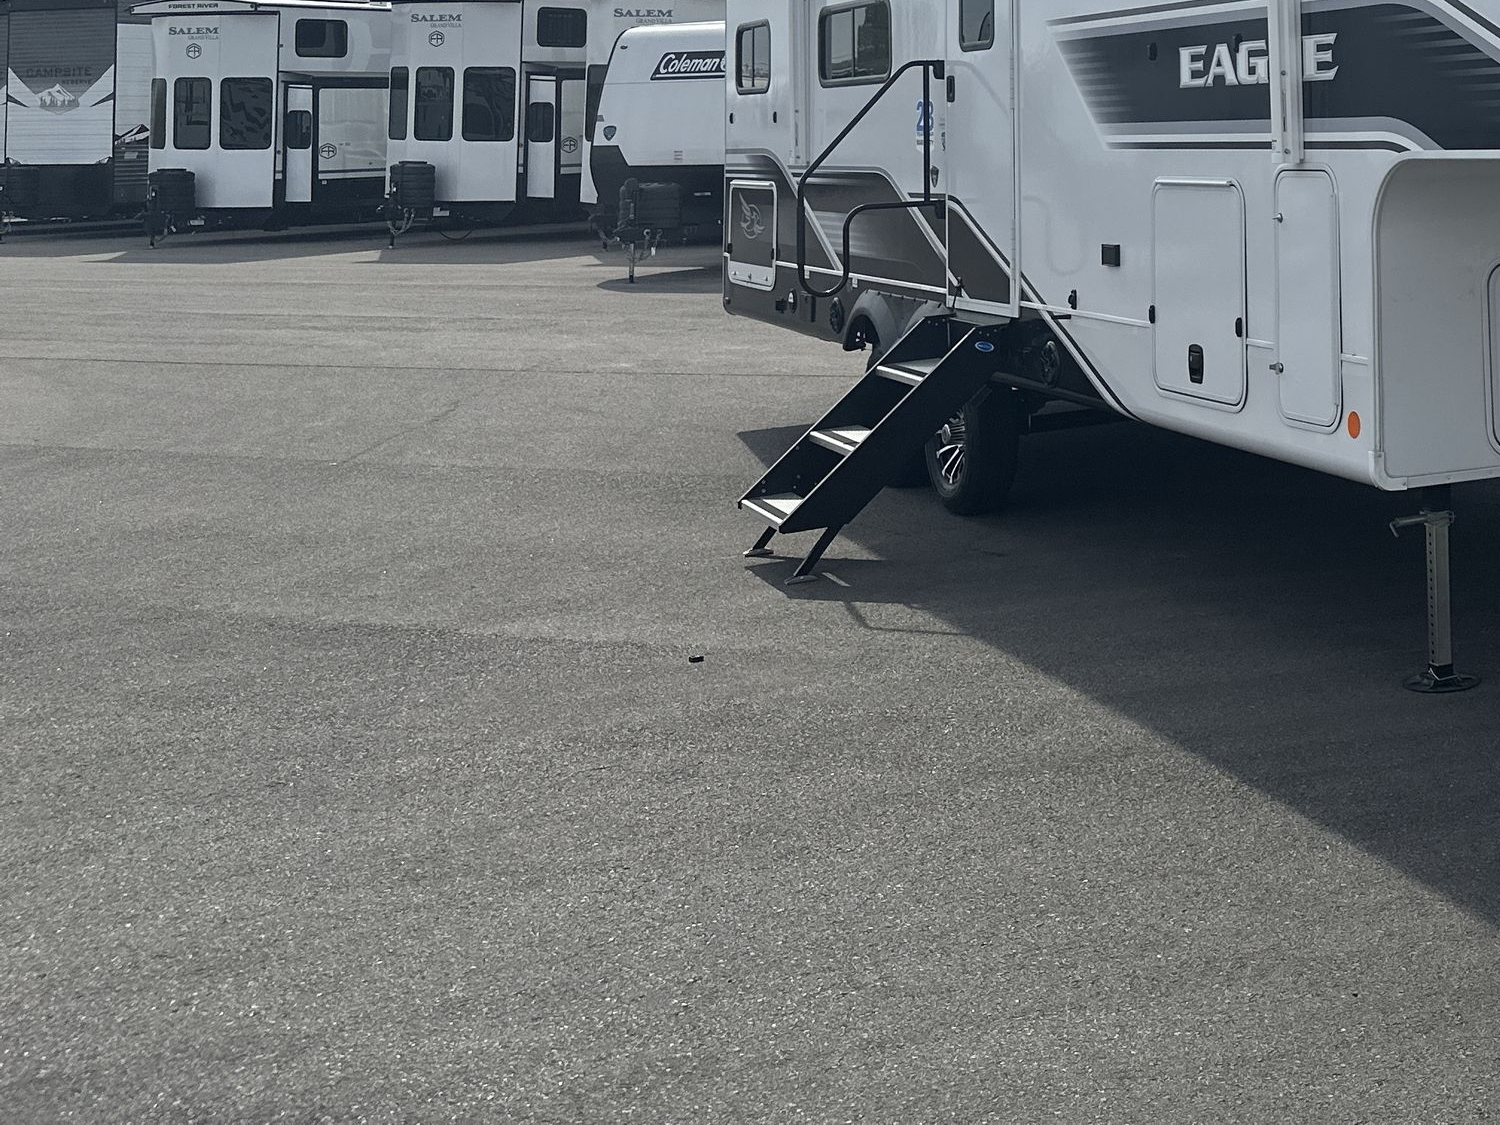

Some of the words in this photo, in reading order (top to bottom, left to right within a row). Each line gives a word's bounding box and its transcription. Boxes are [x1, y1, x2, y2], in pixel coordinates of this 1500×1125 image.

[660, 54, 720, 74] Coleman
[1179, 33, 1339, 88] EAGE
[26, 66, 92, 78] CAMPSITE
